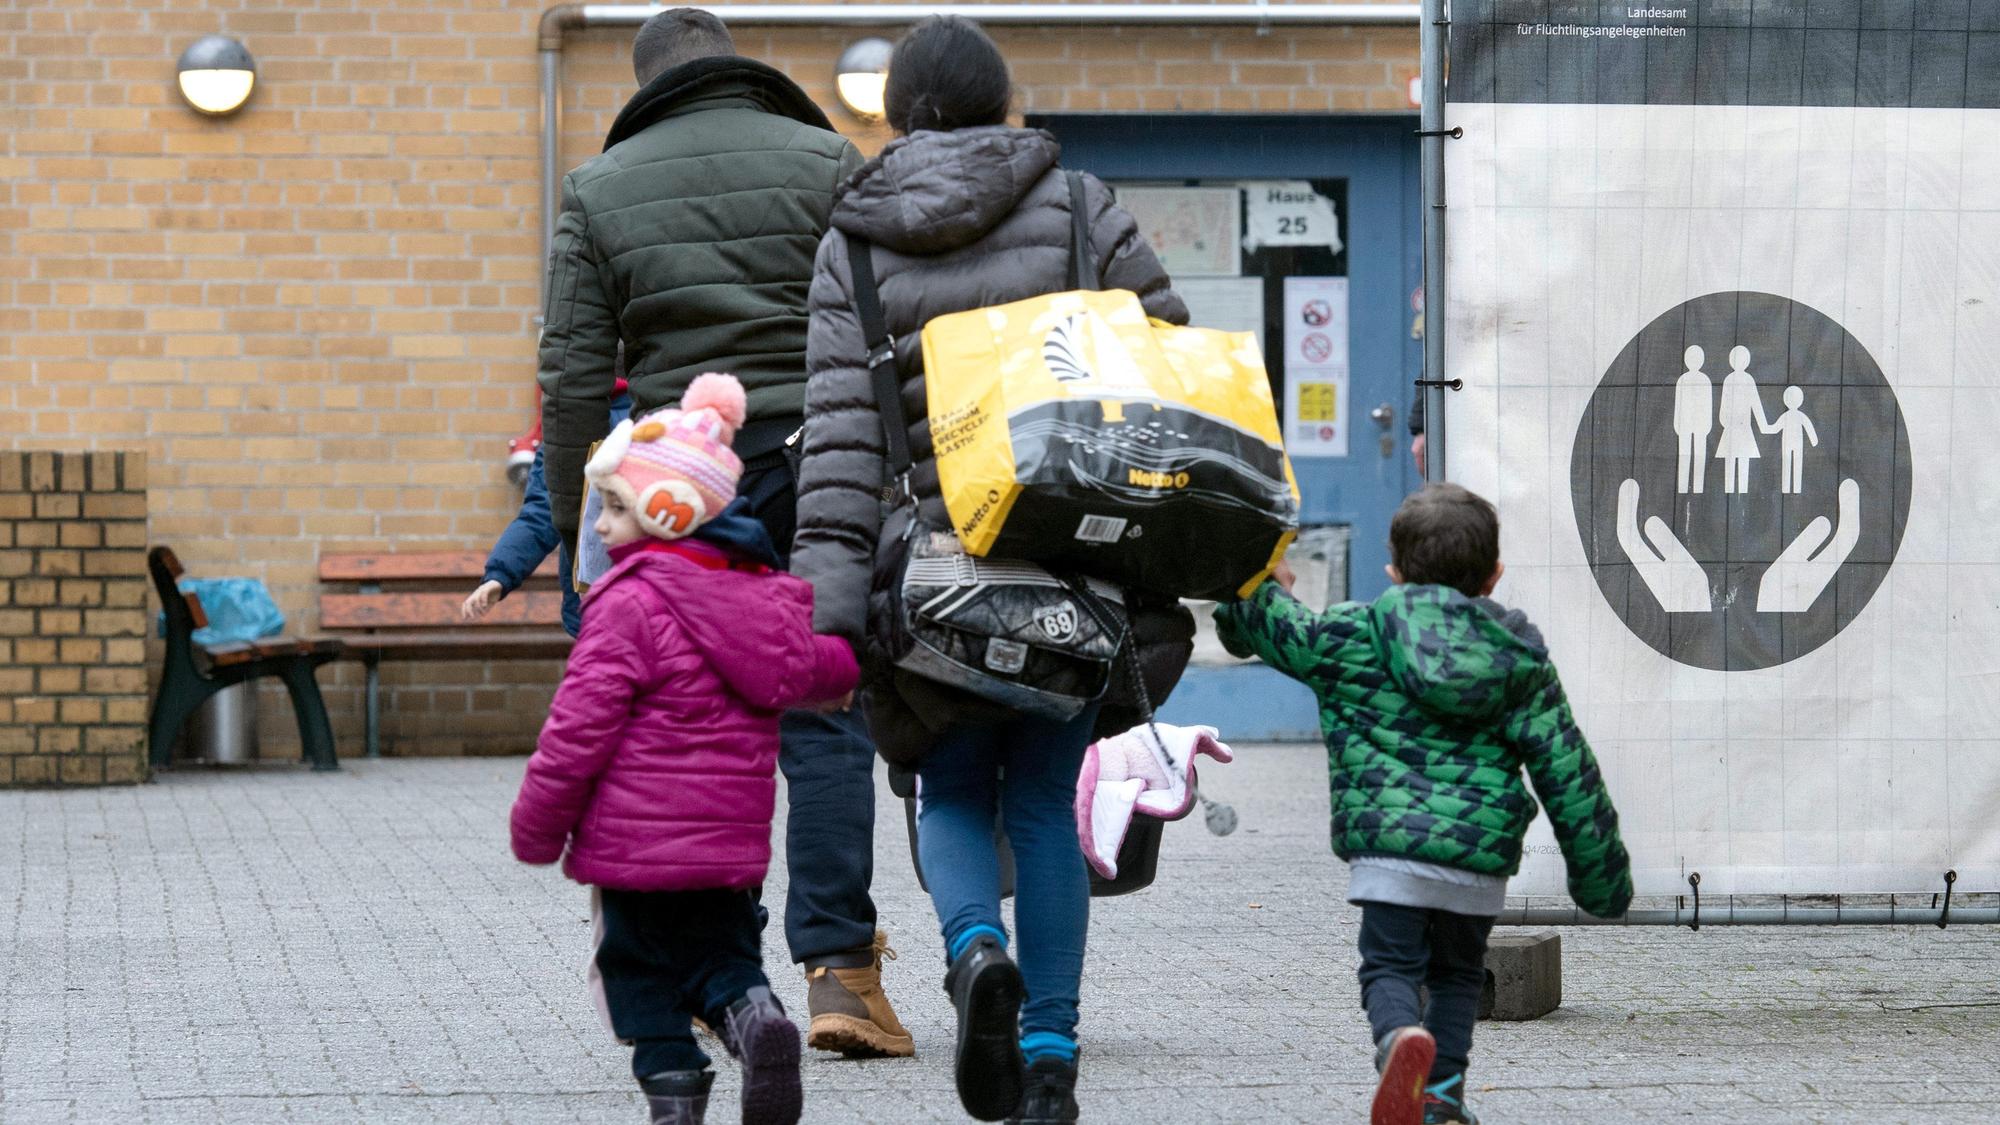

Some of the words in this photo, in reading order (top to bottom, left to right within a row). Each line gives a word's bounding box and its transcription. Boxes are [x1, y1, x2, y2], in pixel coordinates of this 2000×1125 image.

[1627, 6, 1687, 19] Landesamt
[1517, 23, 1533, 36] für
[1536, 23, 1687, 39] Flüchtlingsangelegenheiten
[1267, 189, 1316, 203] Haus
[1278, 216, 1308, 235] 25
[1128, 468, 1174, 488] Netto
[962, 502, 990, 538] Netto
[1043, 611, 1073, 637] 69
